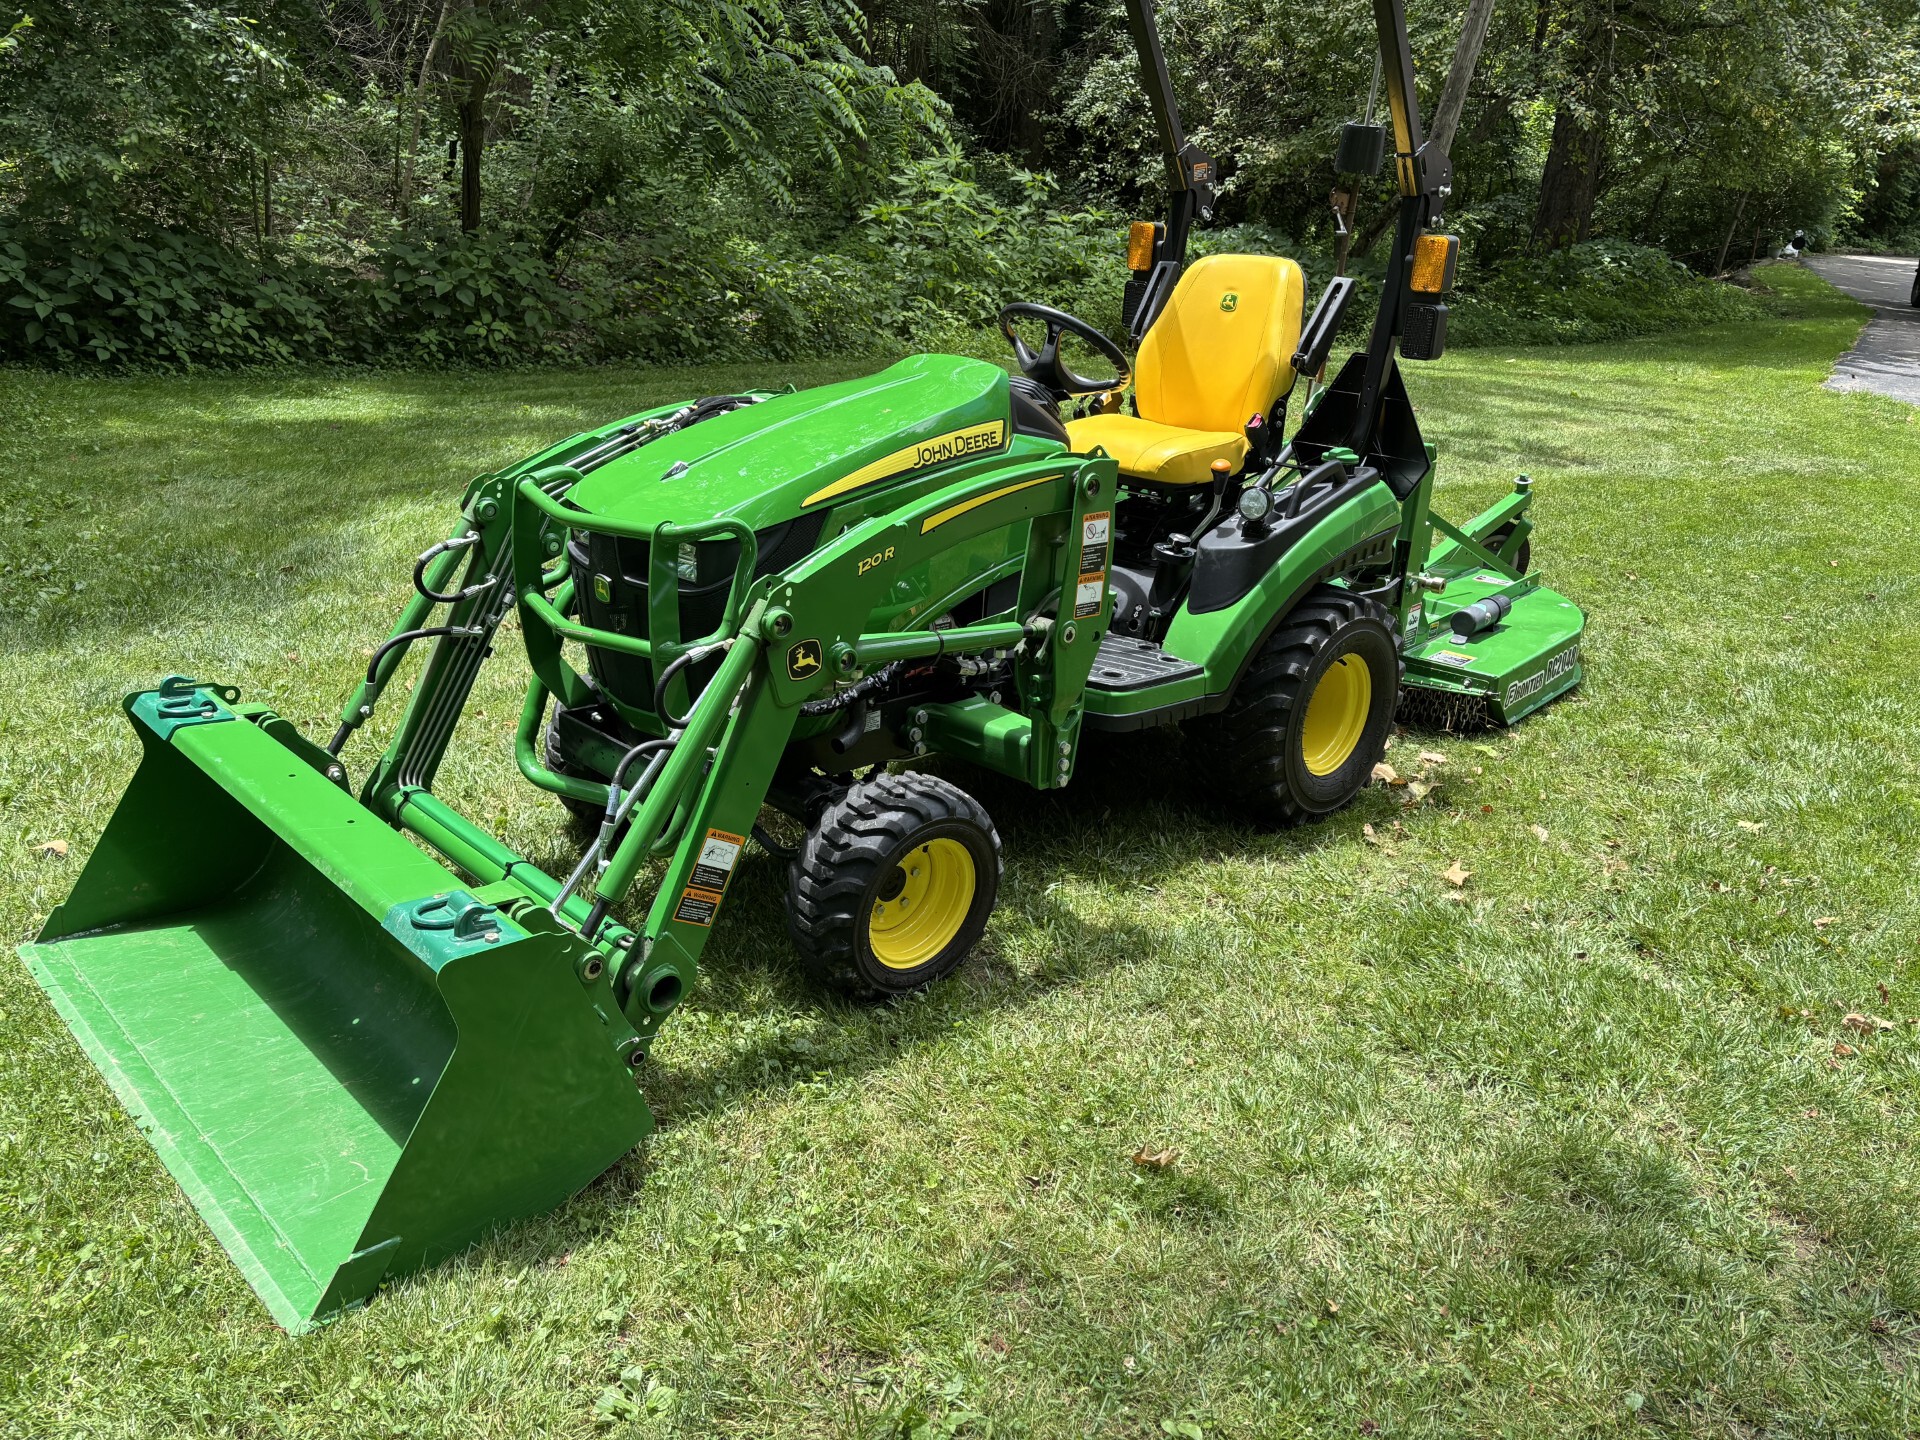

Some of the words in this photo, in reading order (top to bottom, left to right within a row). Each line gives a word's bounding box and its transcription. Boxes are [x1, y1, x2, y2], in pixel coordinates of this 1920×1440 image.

[913, 441, 953, 467] JOHN
[954, 431, 998, 453] DEERE
[857, 553, 883, 576] 120
[884, 546, 895, 561] R
[1505, 671, 1544, 707] FRONTIER
[717, 832, 740, 843] WARNING
[693, 891, 717, 902] WARNING
